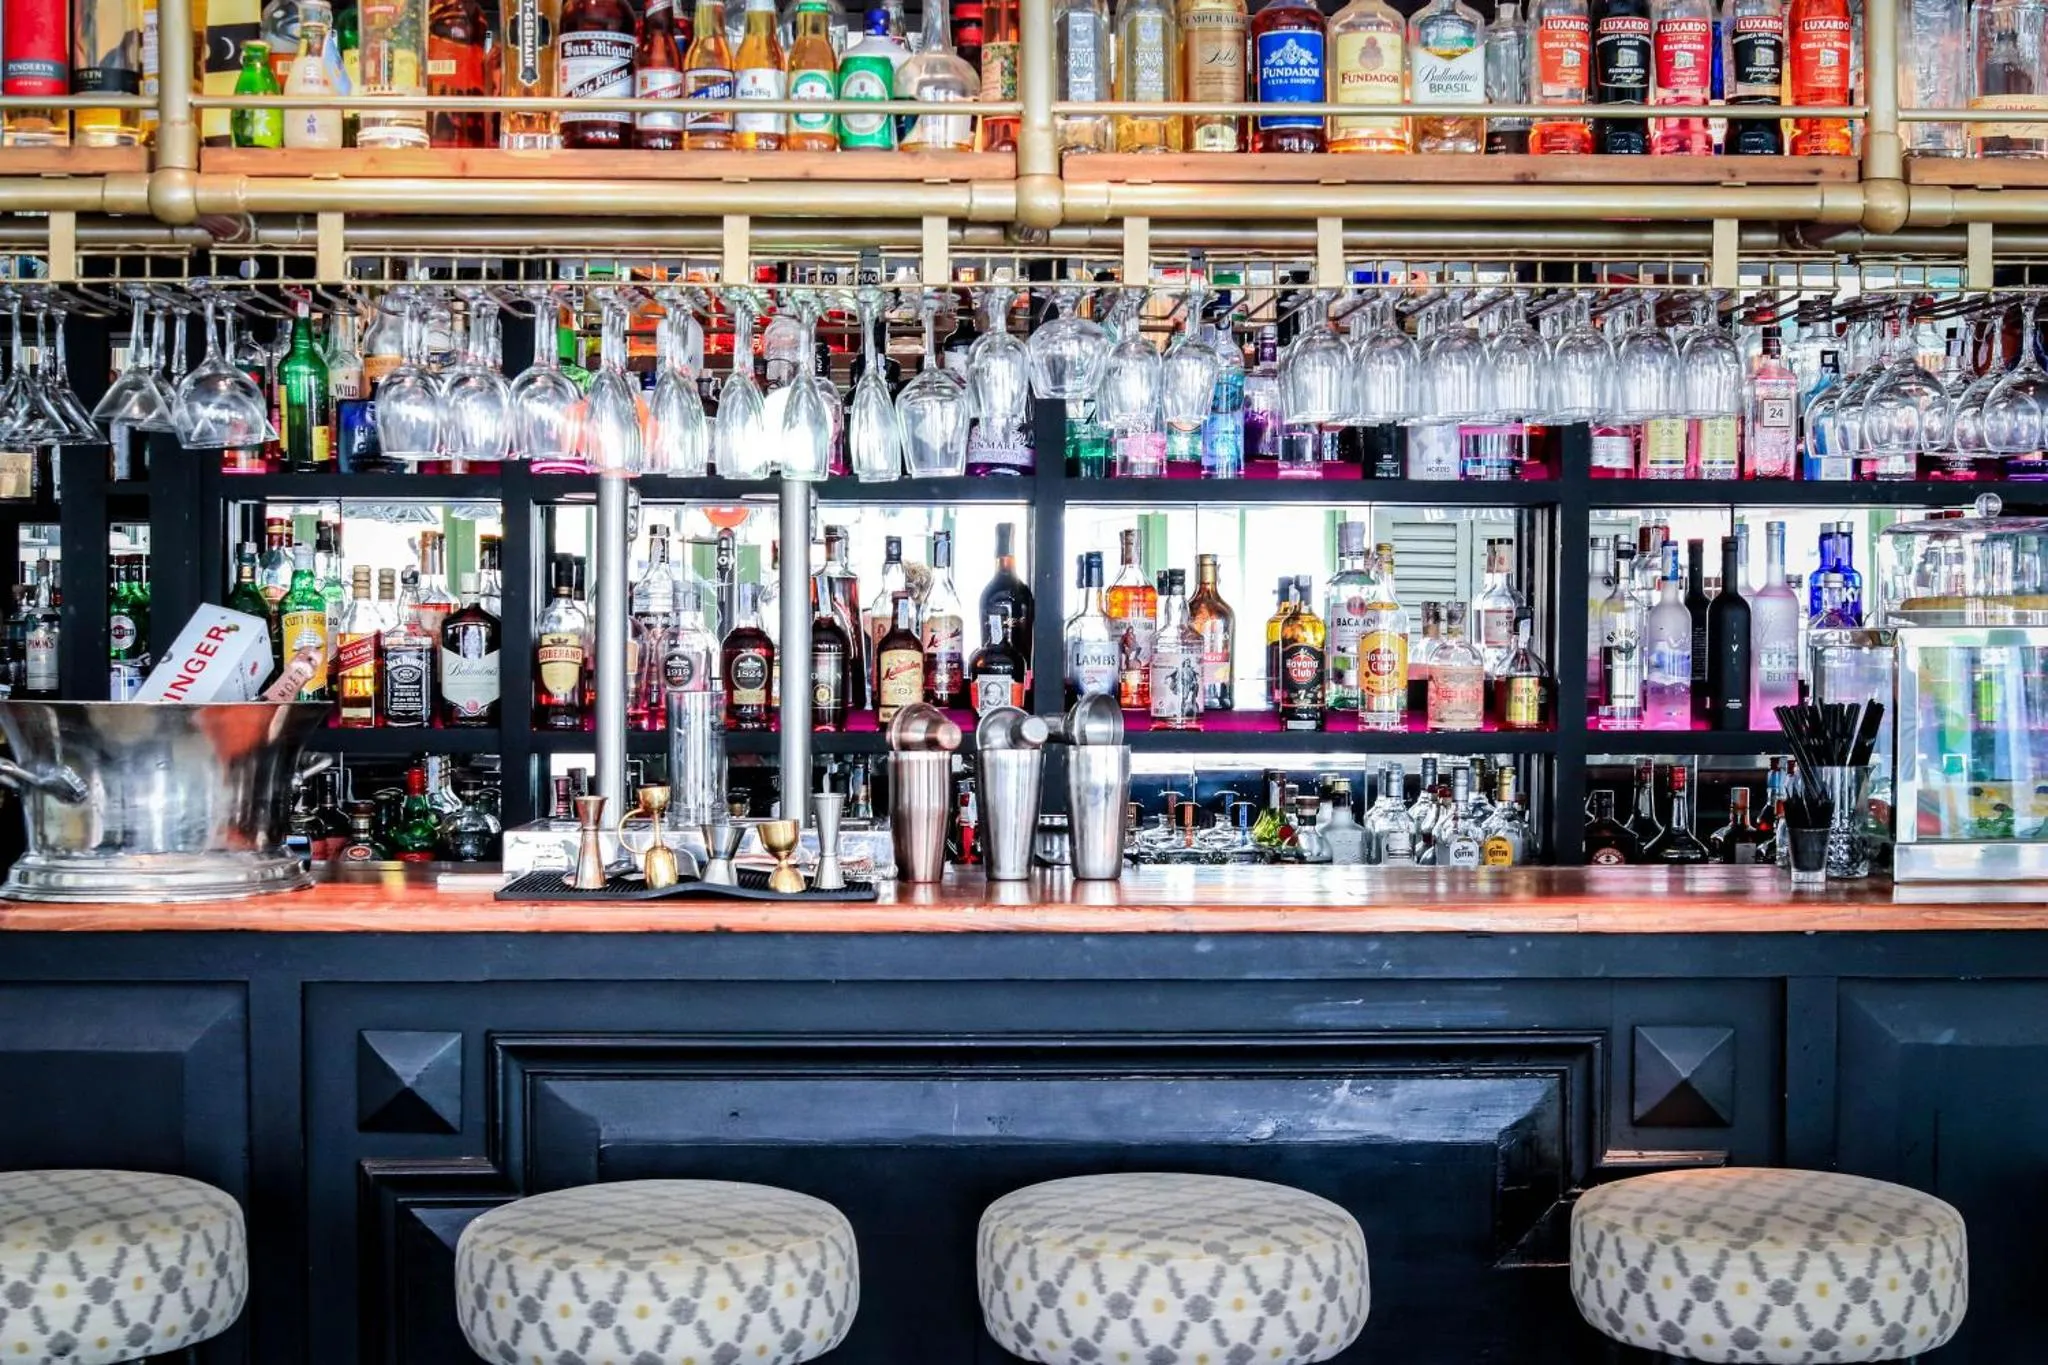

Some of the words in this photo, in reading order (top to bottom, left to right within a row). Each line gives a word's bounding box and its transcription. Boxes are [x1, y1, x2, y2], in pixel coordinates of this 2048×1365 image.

[1603, 21, 1649, 31] LUXARDO
[1660, 21, 1708, 33] LUXARDO
[1740, 19, 1783, 31] LUXARDO
[1804, 20, 1850, 31] LUXARDO
[523, 0, 535, 67] T-GERMAIN
[564, 41, 588, 57] San
[590, 40, 634, 58] Miguel
[1262, 67, 1320, 79] FUNDADOR
[1341, 72, 1399, 85] FUNDADOR
[1429, 83, 1471, 93] BRASIL
[1769, 407, 1784, 419] 24
[163, 625, 239, 702] INGER
[1372, 662, 1393, 672] Club
[666, 668, 691, 677] 1919
[737, 669, 764, 678] 1824
[1292, 668, 1312, 677] Club
